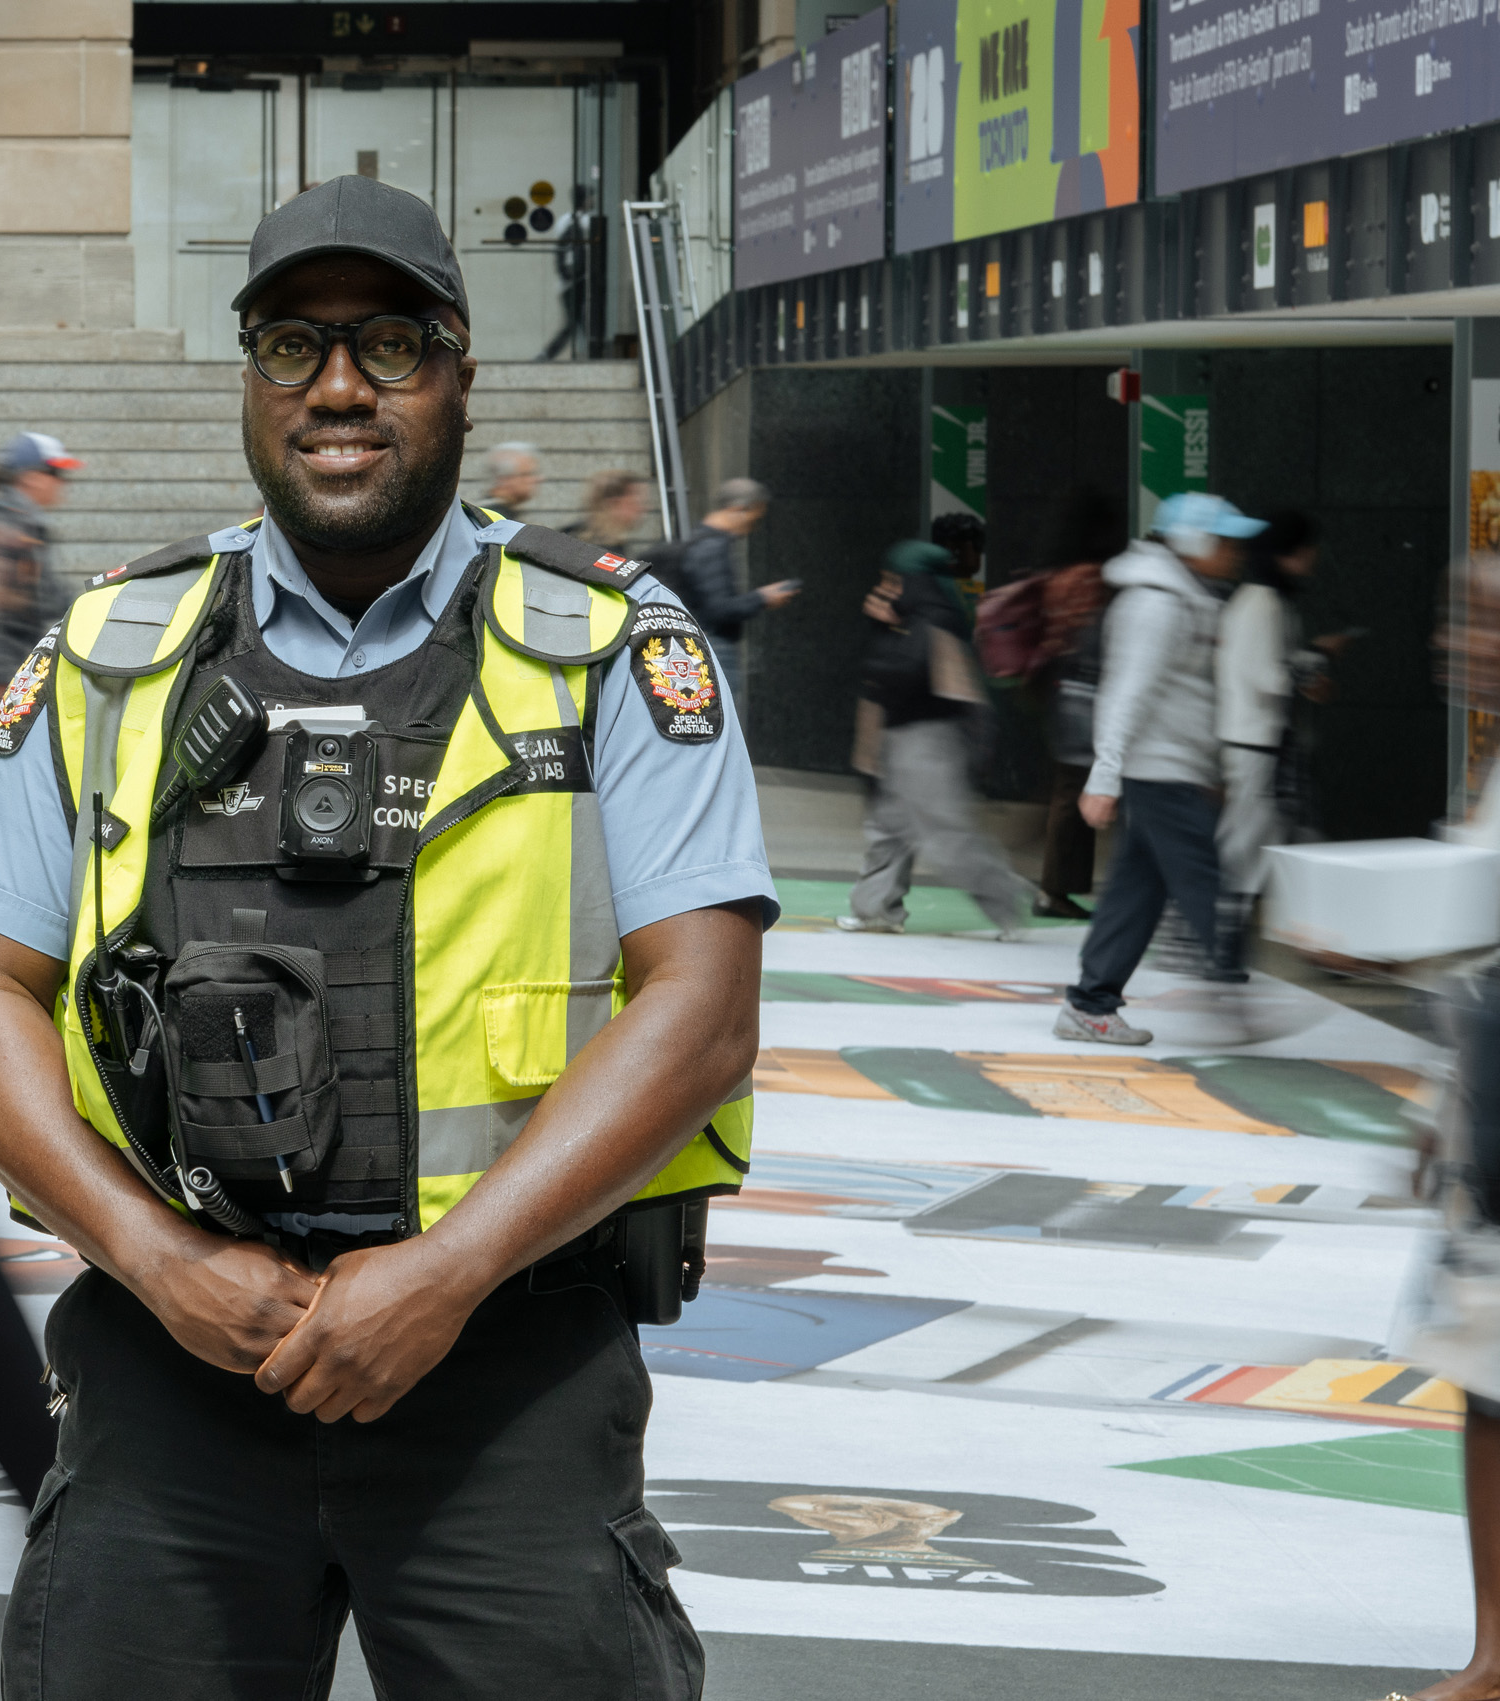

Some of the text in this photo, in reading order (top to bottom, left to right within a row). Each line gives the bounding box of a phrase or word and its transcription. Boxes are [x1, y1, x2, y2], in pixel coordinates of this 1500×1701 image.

[1184, 409, 1209, 478] MESSI
[637, 607, 686, 620] TRANSIT
[673, 715, 709, 725] SPECIAL
[669, 724, 714, 735] CONSTABLE
[310, 837, 333, 845] AXON
[798, 1562, 1034, 1586] FIFA
